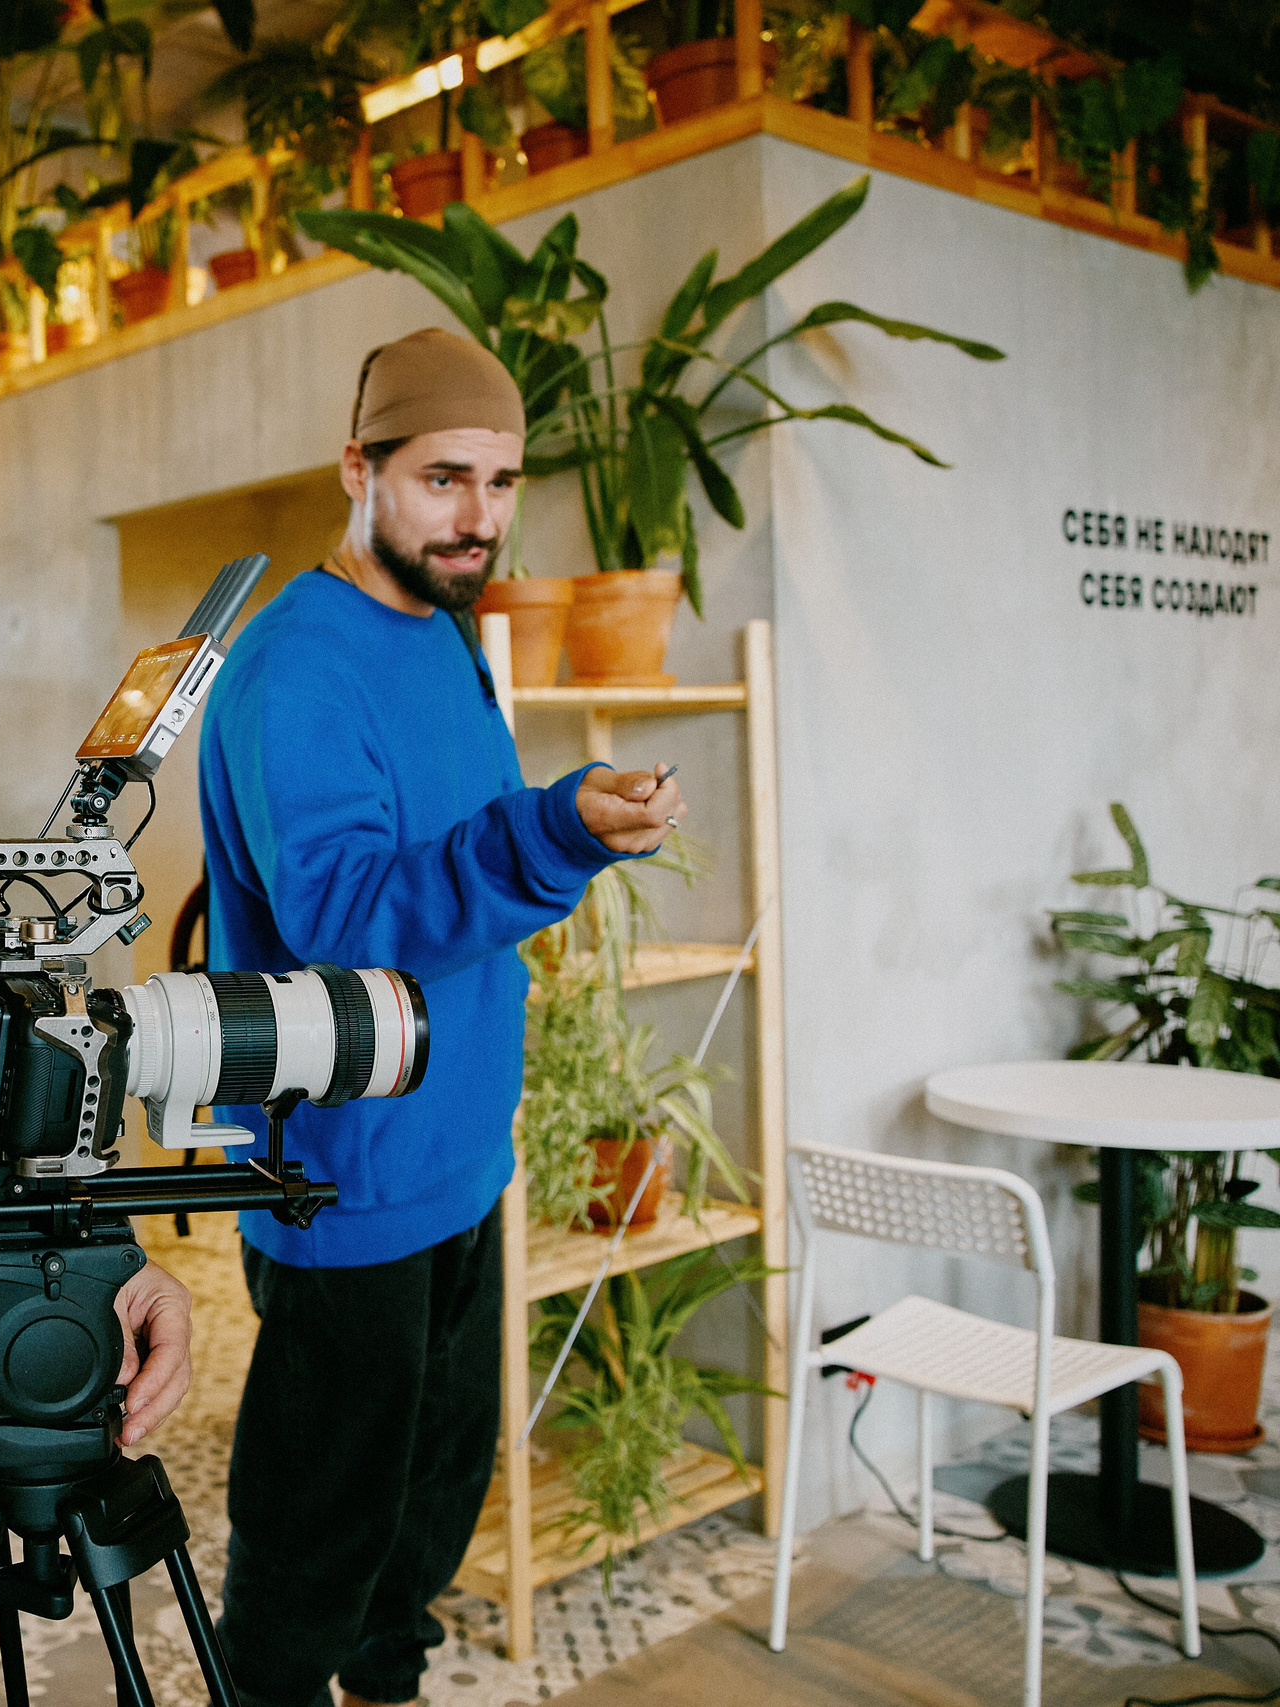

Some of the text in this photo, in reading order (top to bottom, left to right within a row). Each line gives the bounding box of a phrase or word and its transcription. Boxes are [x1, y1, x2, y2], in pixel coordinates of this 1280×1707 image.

[1063, 508, 1270, 566] СЕБЯ НЕ НАХОДЯТ
[1081, 572, 1258, 621] СЕБЯ СОЗДАЮТ
